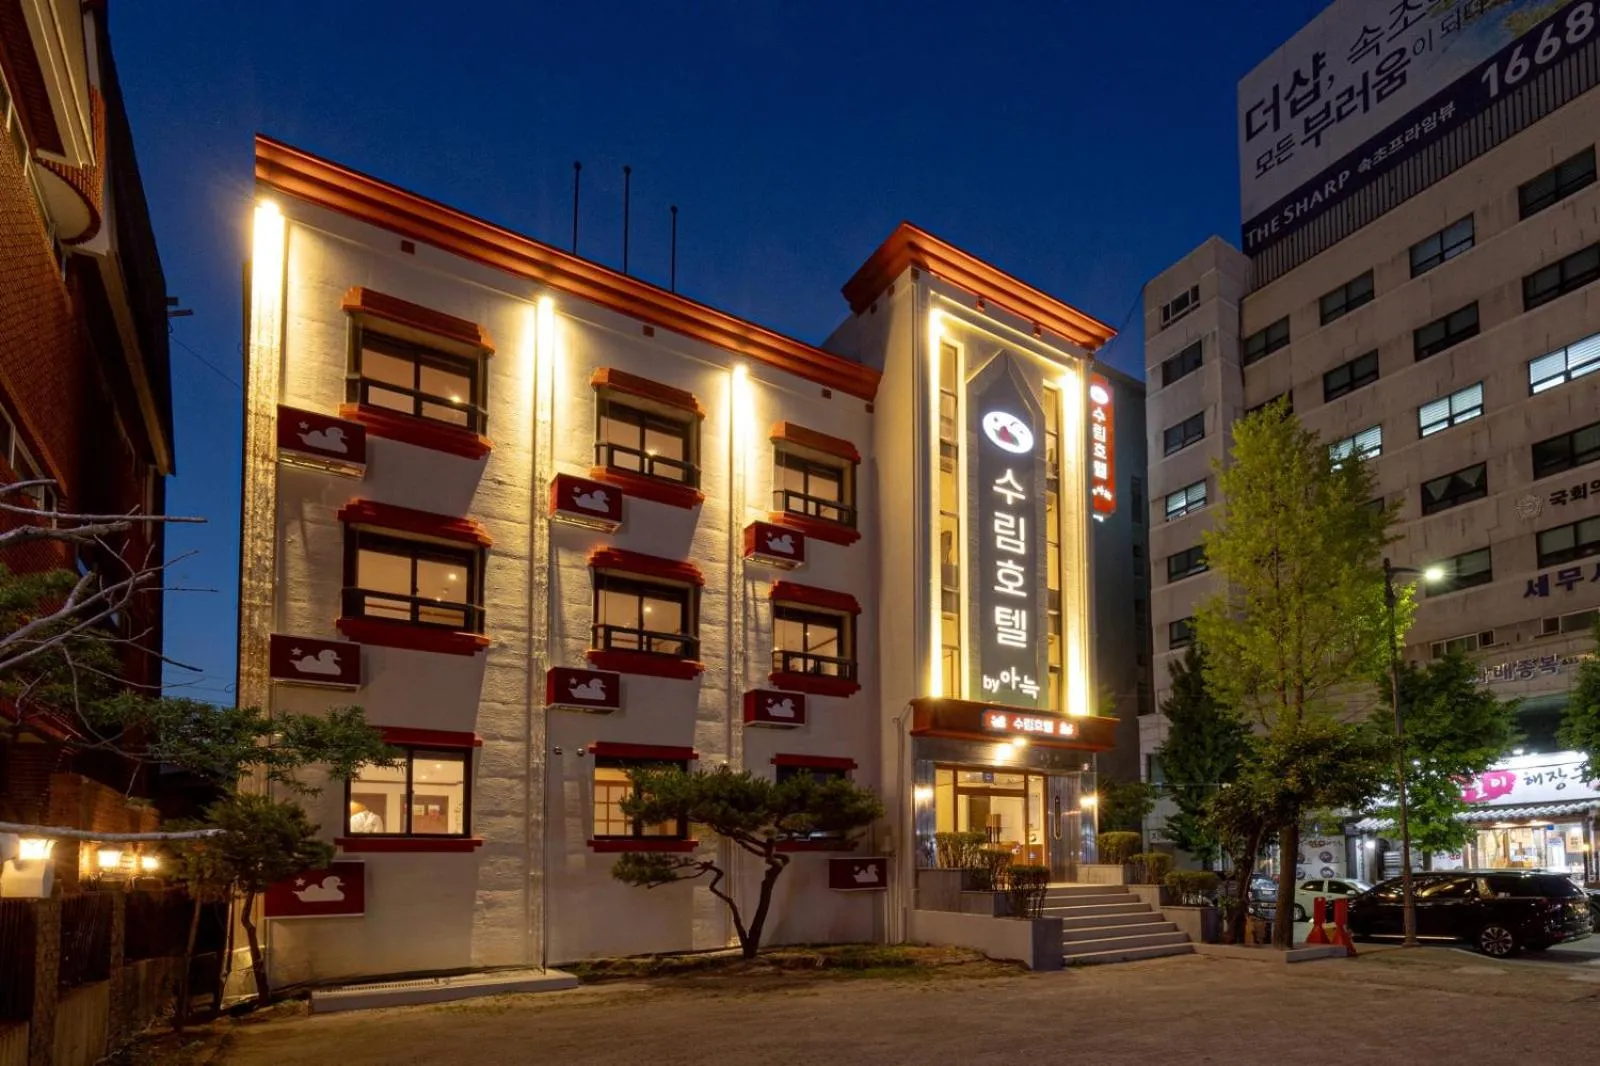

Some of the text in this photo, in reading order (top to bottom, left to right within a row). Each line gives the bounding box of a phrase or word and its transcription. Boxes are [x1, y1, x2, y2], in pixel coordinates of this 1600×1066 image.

[1245, 51, 1335, 142] 더샵,
[1245, 1, 1595, 249] THE SHARP 속초프라임뷰 1668
[1255, 133, 1296, 180] 모든
[992, 468, 1028, 648] 수림호텔
